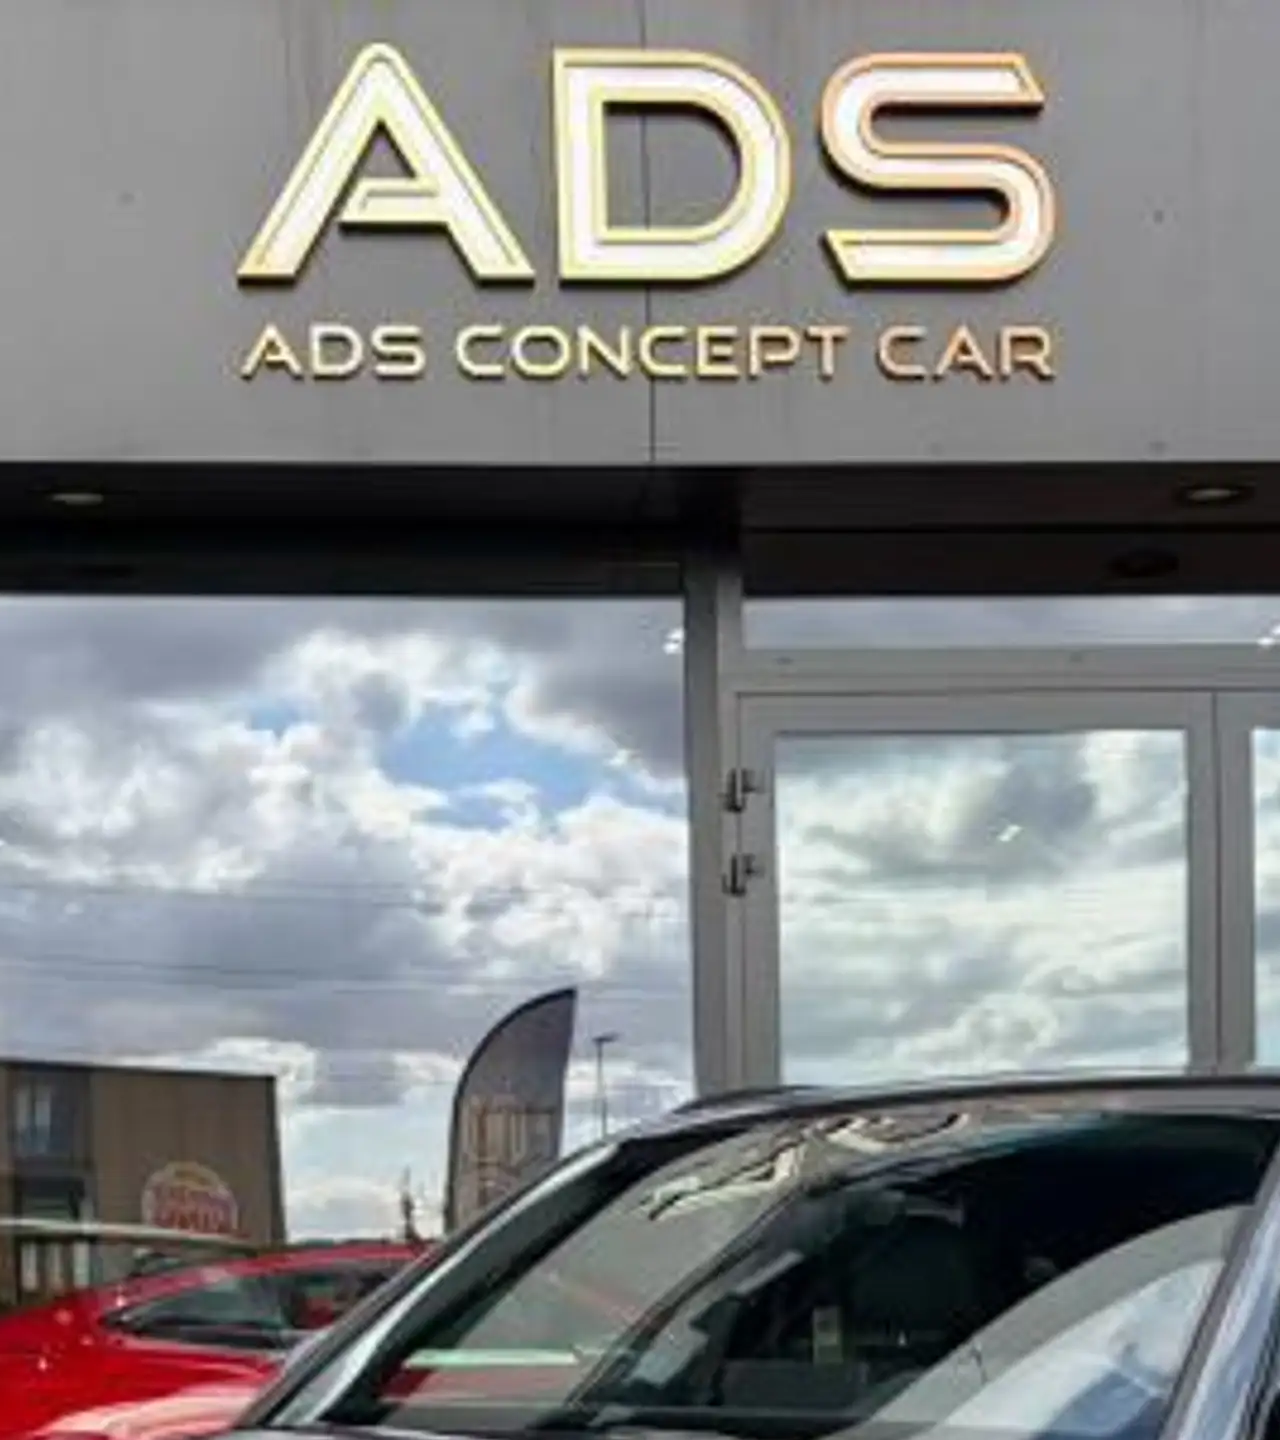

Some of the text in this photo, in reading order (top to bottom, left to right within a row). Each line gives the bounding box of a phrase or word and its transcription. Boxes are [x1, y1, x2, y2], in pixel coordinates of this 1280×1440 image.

[237, 41, 1058, 286] ADS
[240, 323, 1056, 381] ADS CONCEPT CAR
